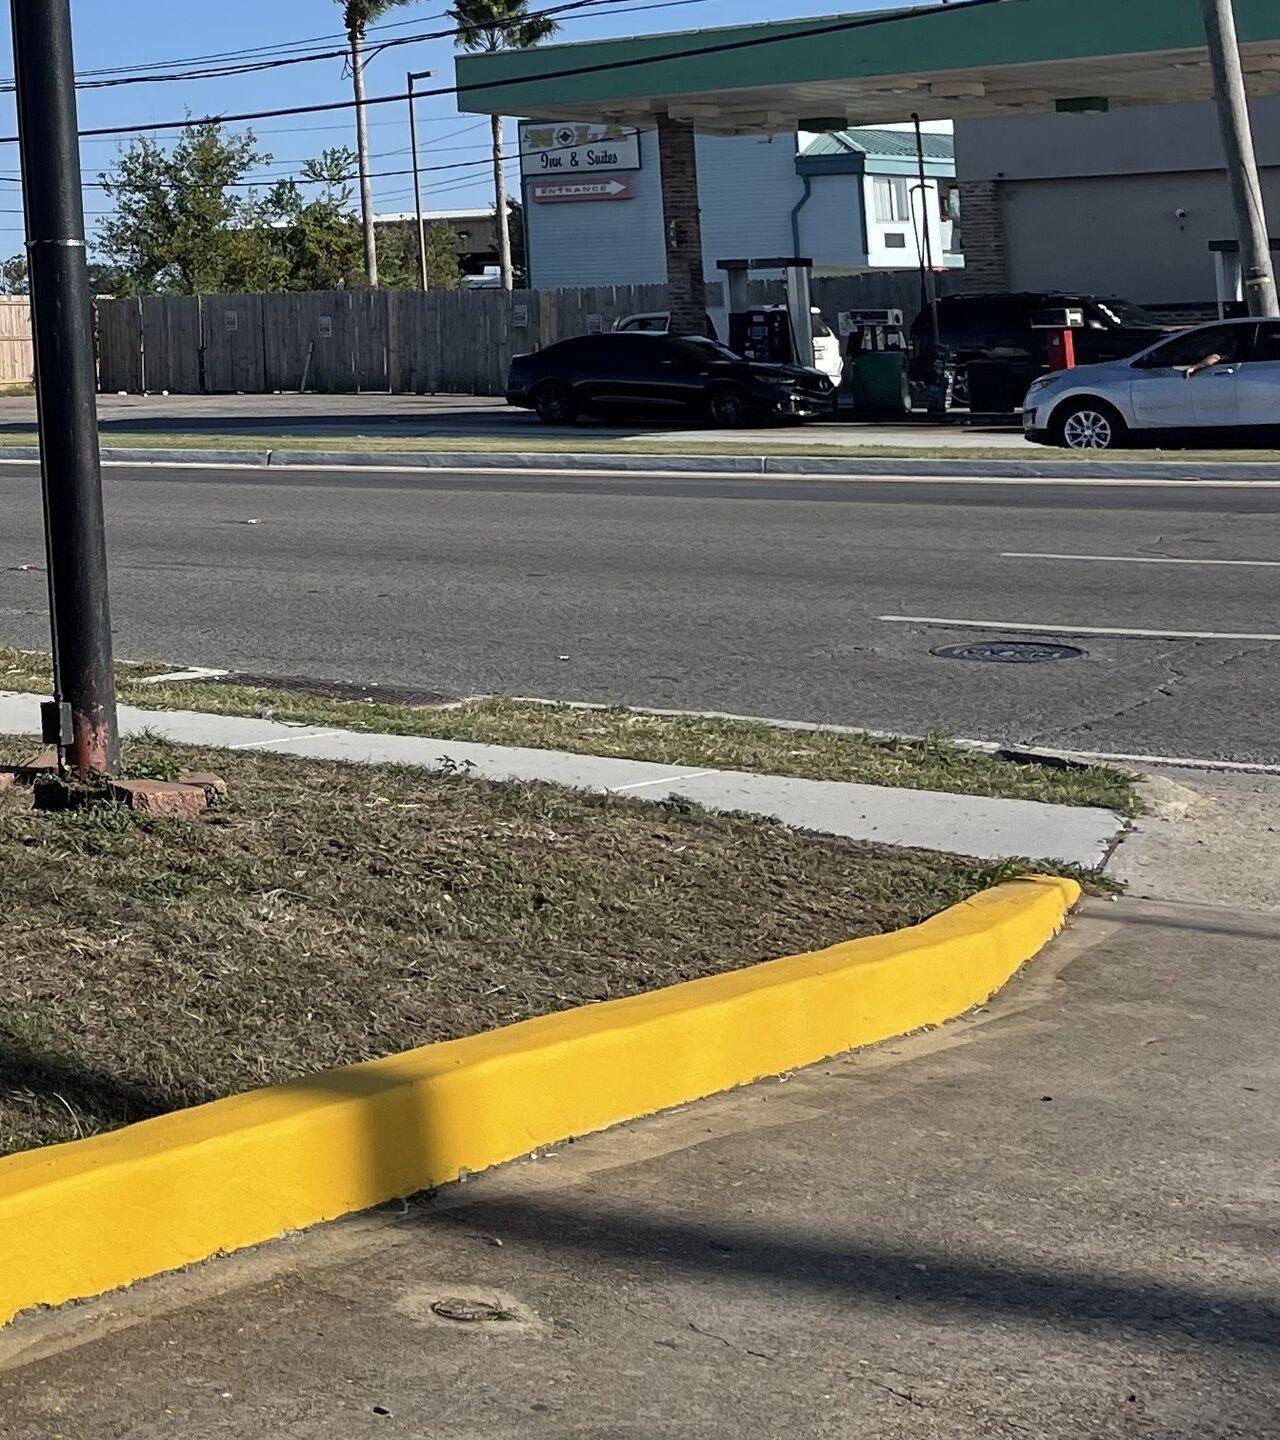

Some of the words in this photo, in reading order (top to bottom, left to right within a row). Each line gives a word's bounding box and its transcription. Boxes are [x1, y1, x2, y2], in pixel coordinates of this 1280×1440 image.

[541, 152, 562, 169] Inn
[570, 152, 579, 167] &
[587, 150, 618, 166] Suites
[541, 184, 607, 195] ENTRANCE
